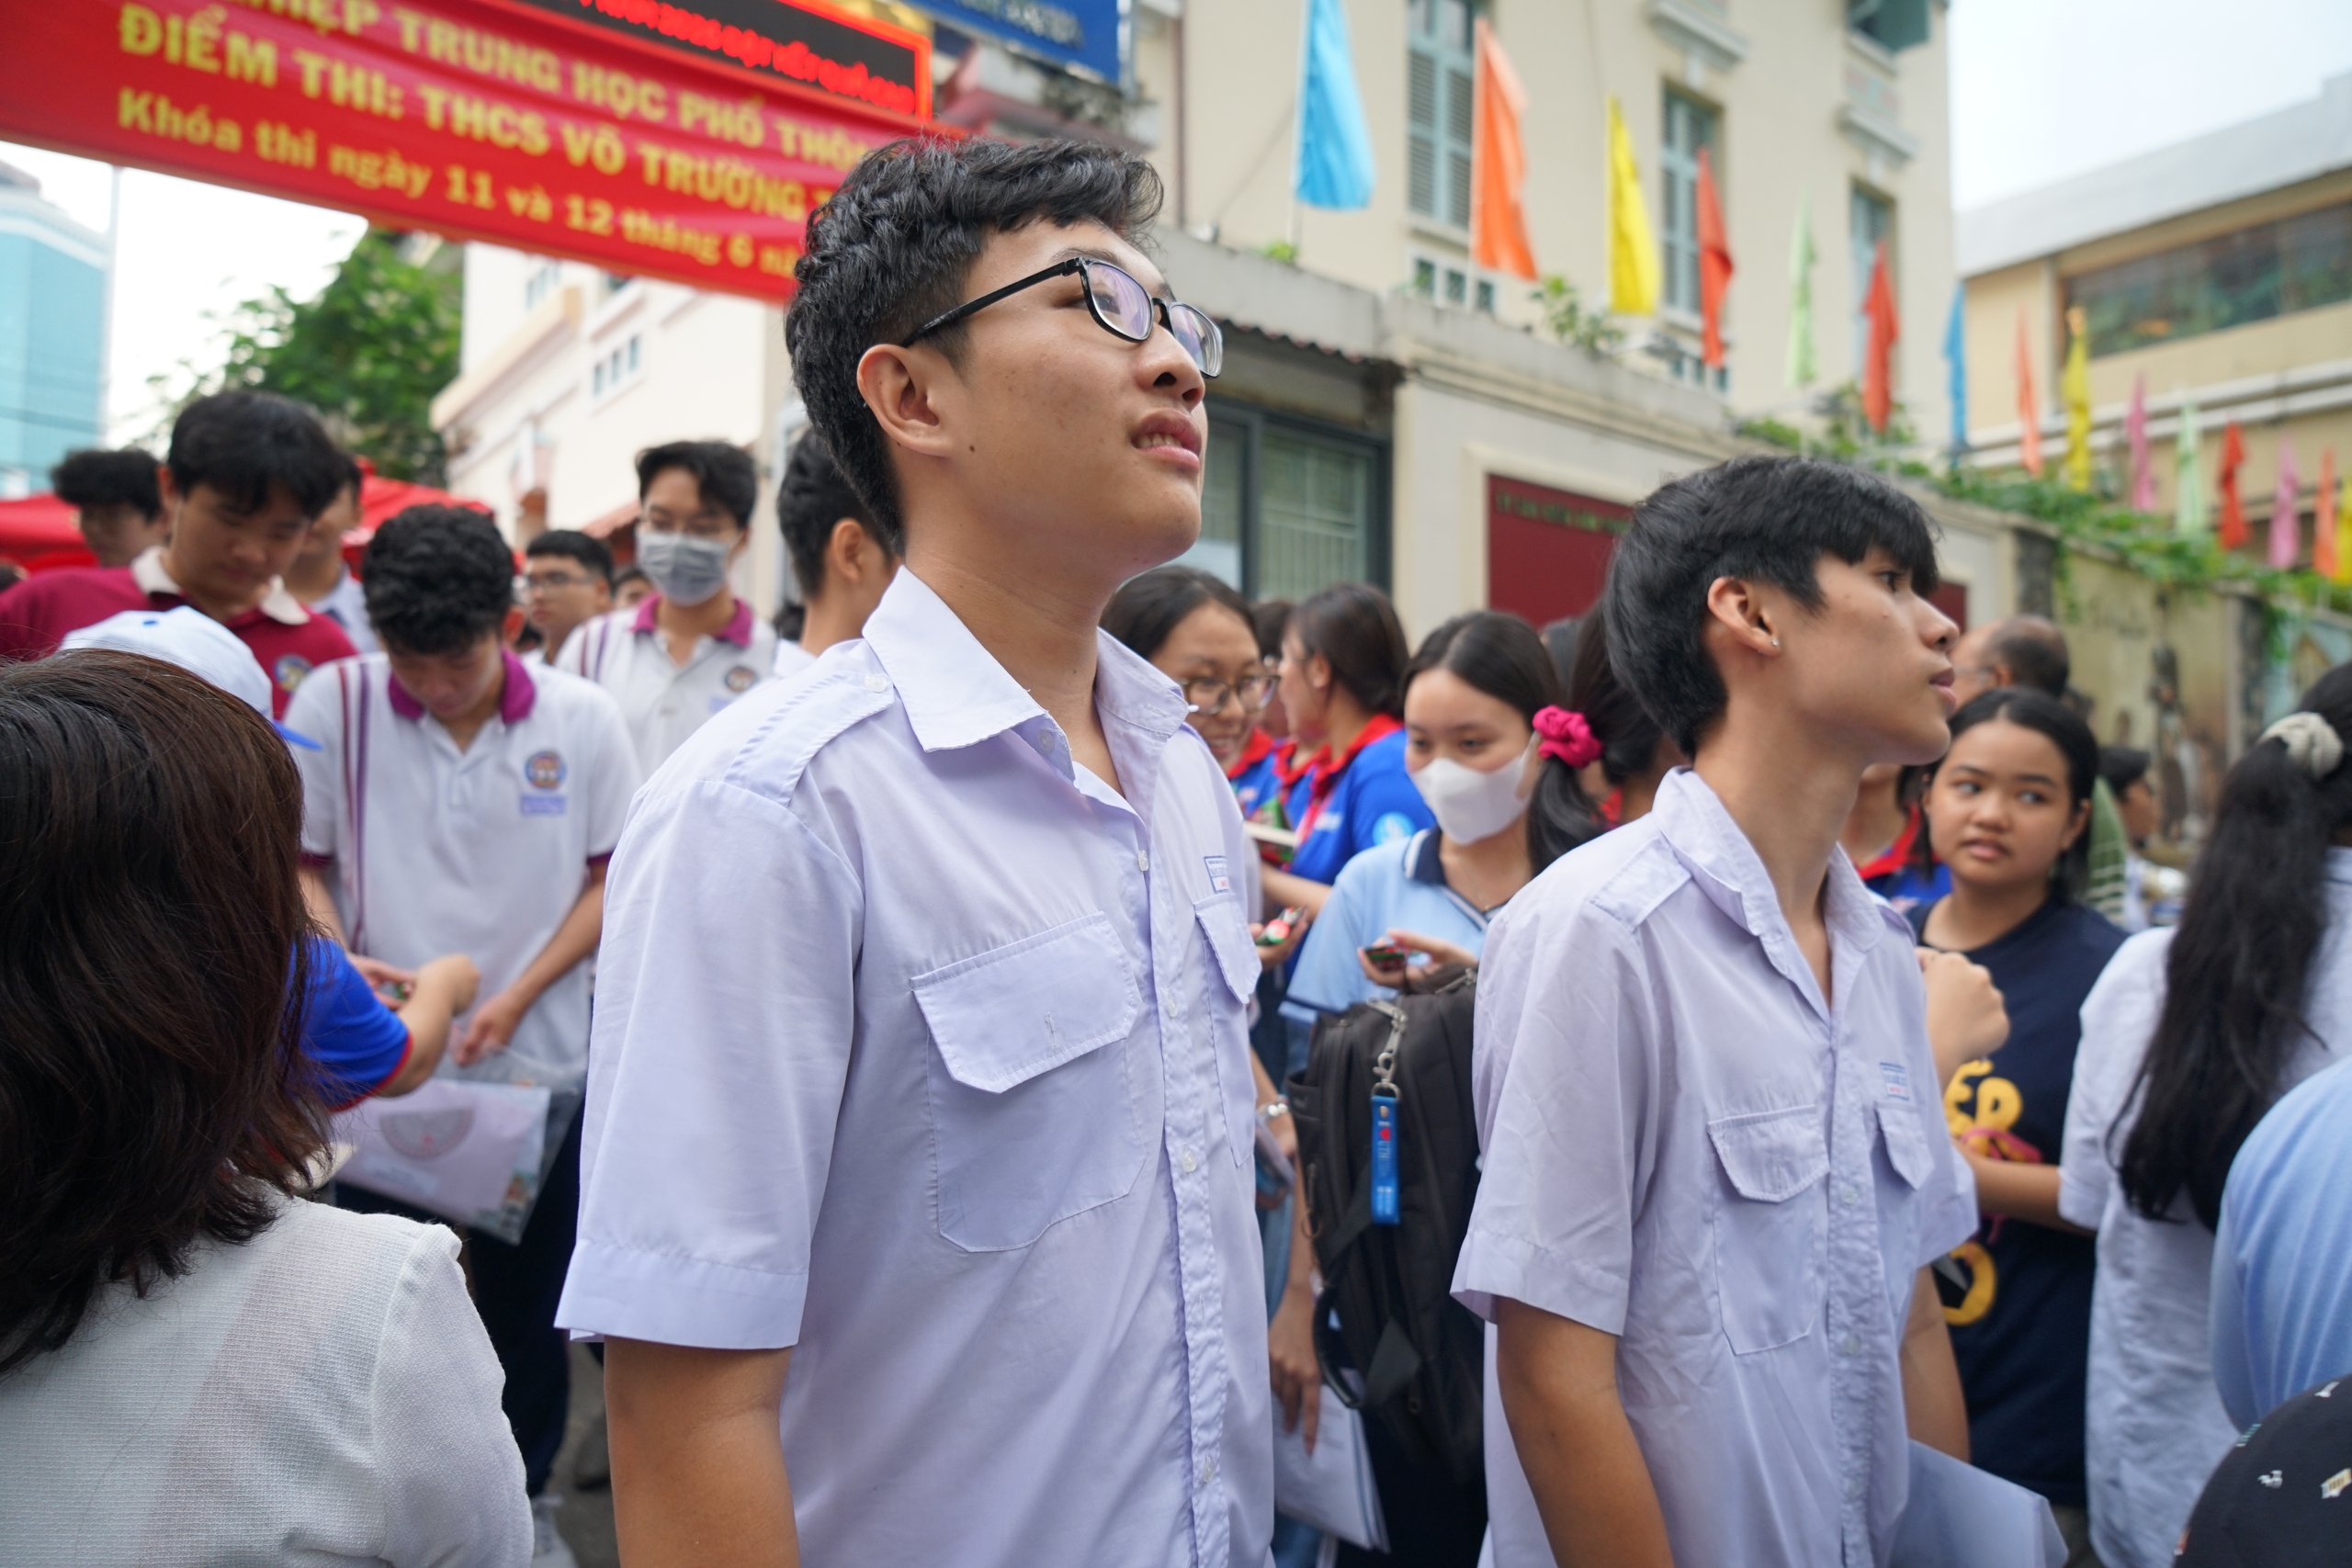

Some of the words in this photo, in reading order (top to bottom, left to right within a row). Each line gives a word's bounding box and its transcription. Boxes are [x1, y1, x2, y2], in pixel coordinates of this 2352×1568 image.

[118, 3, 277, 87] ĐIỂM
[293, 50, 404, 118] THI:
[419, 85, 550, 155] THCS
[561, 122, 626, 175] VÕ
[639, 142, 806, 220] TRƯỜNG
[393, 8, 560, 93] TRUNG
[573, 61, 666, 119] HỌC
[119, 86, 242, 152] Khóa
[254, 119, 317, 169] thi
[328, 145, 432, 198] ngày
[447, 165, 494, 209] 11
[506, 184, 552, 222] và
[565, 194, 613, 236] 12
[622, 208, 720, 265] tháng
[727, 233, 754, 267] 6
